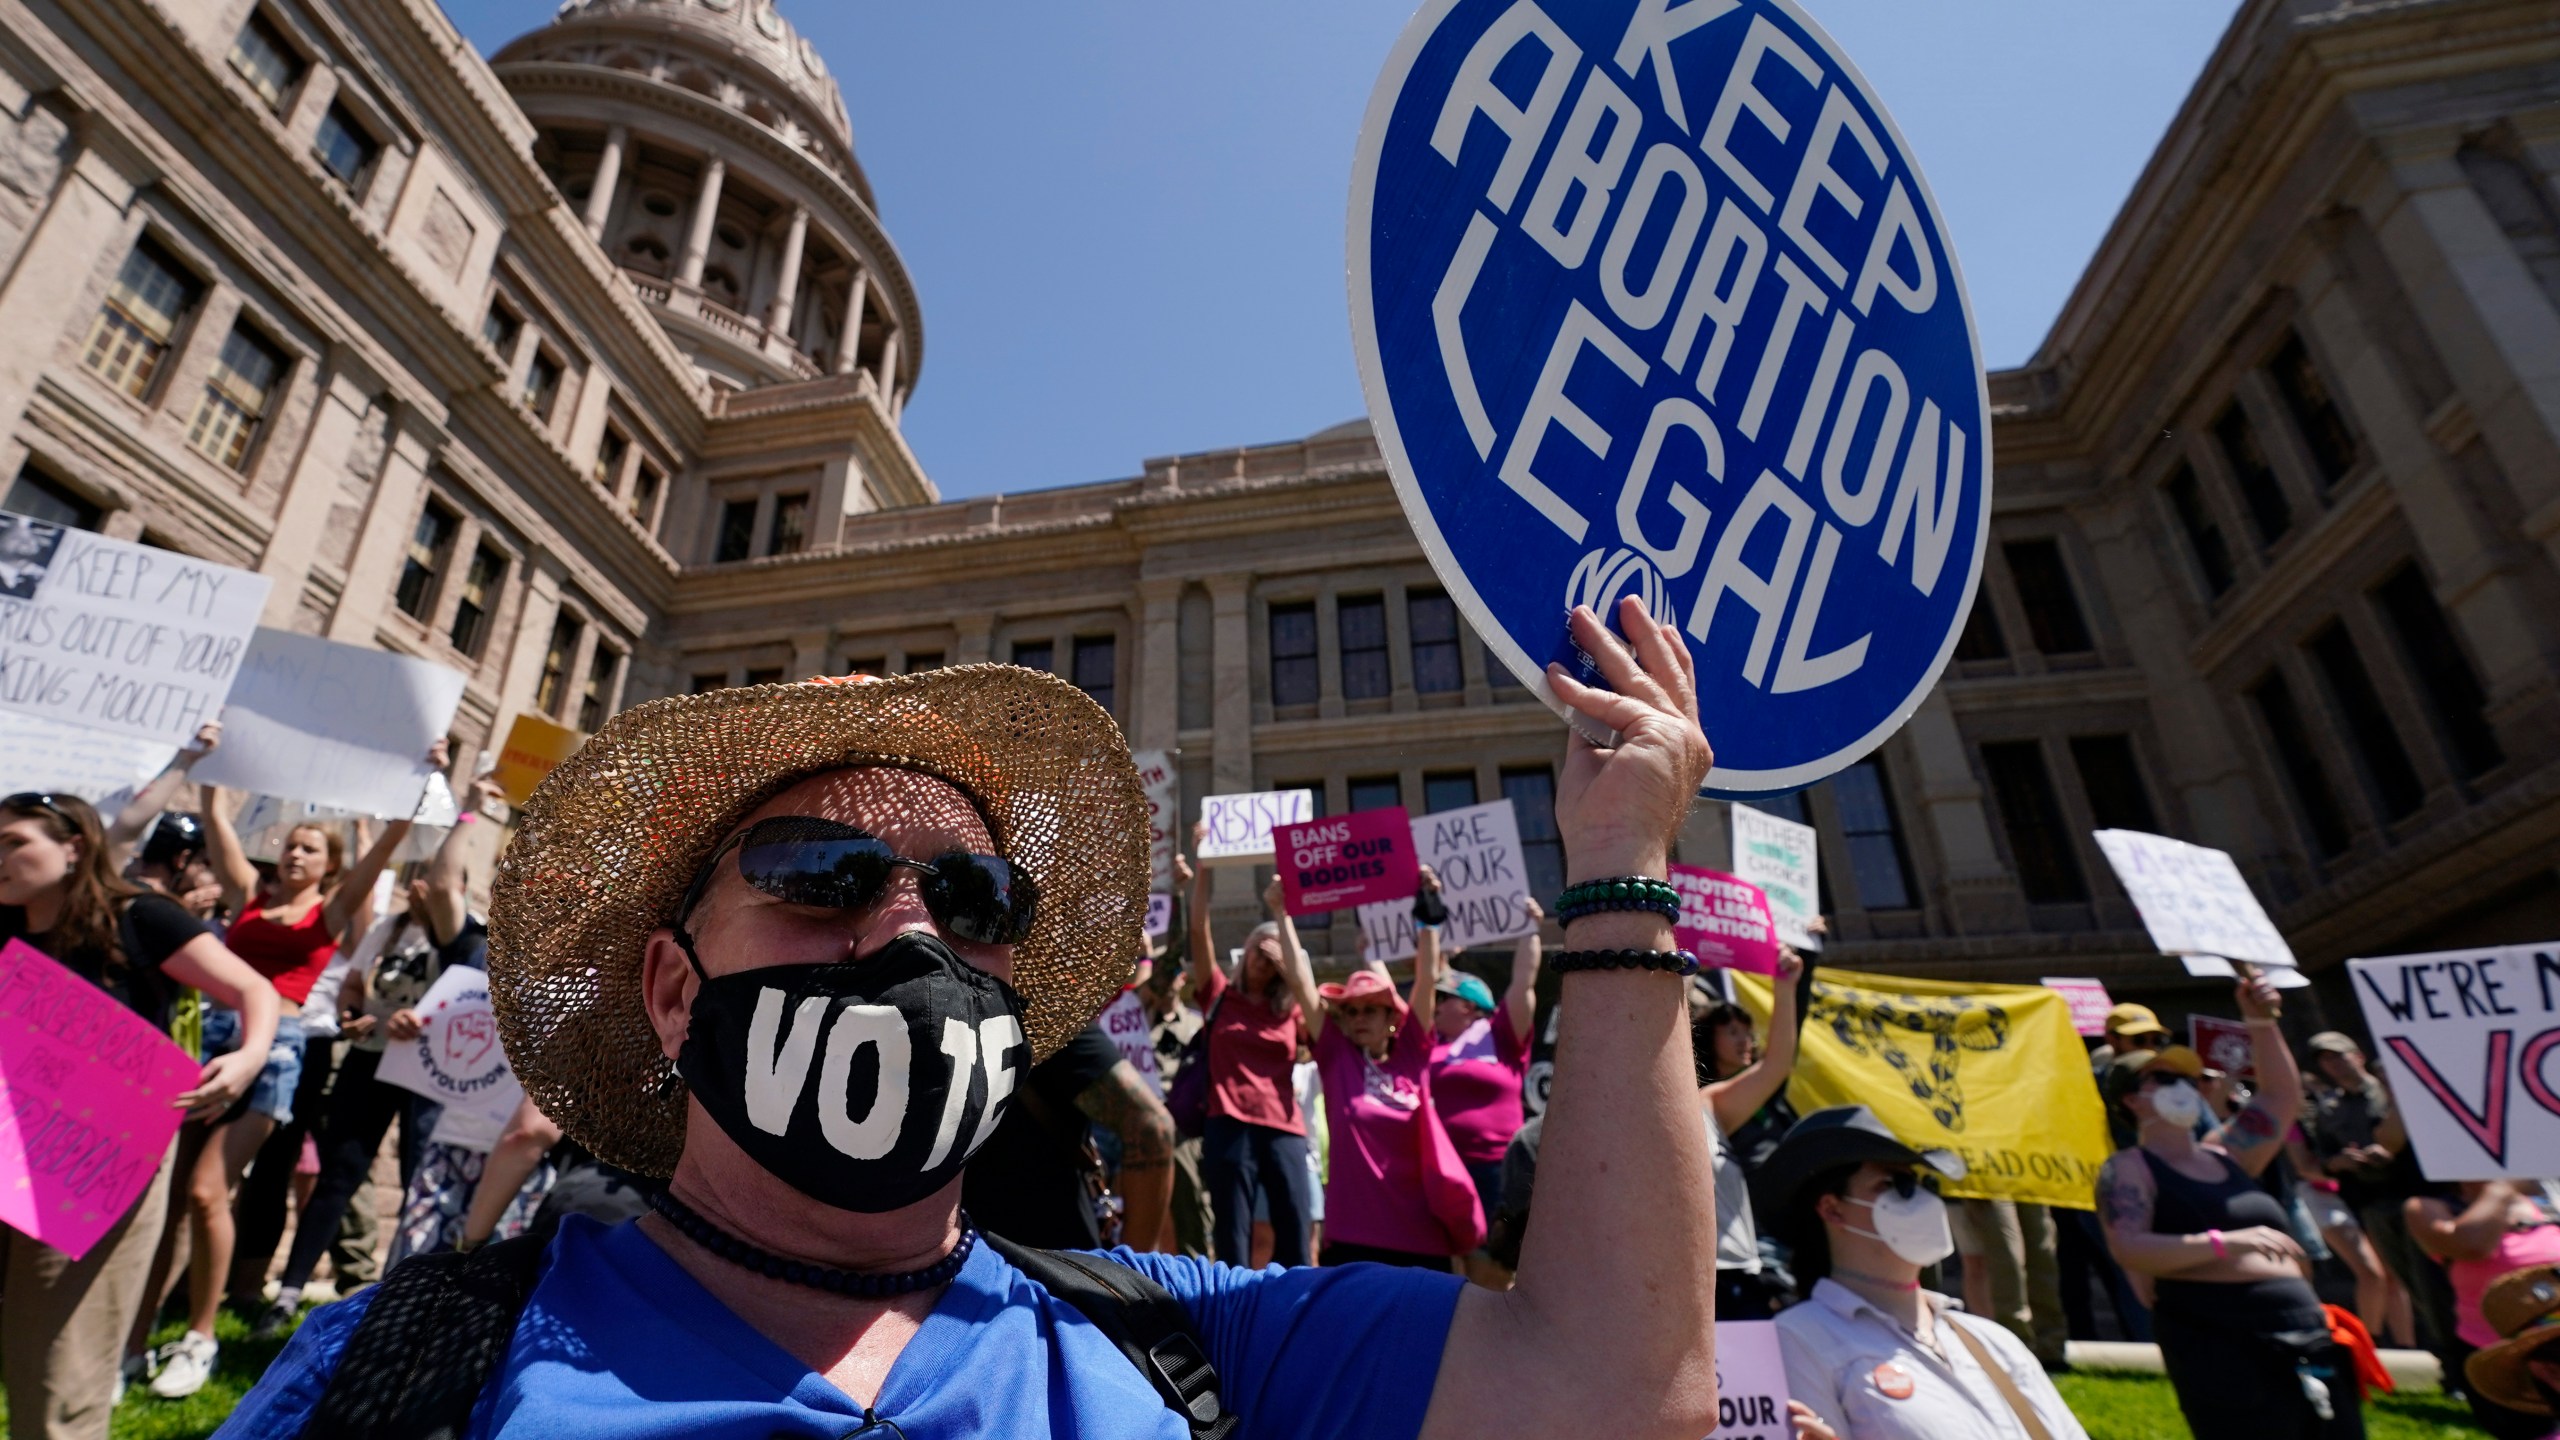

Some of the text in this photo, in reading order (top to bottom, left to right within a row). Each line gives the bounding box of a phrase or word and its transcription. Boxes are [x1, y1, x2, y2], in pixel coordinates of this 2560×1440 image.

[1614, 0, 1938, 318] KEEP
[1429, 0, 1966, 598] ABORTION
[1432, 209, 1873, 694] LEGAL
[56, 537, 228, 618] KEEP MY
[60, 613, 133, 660] OUT
[124, 622, 170, 667] OF
[174, 629, 242, 681] YOUR
[78, 672, 210, 738] MOUTH
[1290, 822, 1351, 849] BANS
[1294, 844, 1338, 869] OFF
[1342, 838, 1393, 860] OUR
[1434, 812, 1497, 856] ARE
[1298, 860, 1385, 888] BODIES
[1426, 847, 1514, 895] YOUR
[1671, 872, 1754, 905] PROTECT
[1678, 909, 1768, 944] BORTION
[1714, 897, 1770, 928] LEGAL
[2356, 957, 2519, 1022] WE'RE
[745, 986, 1024, 1173] VOTE
